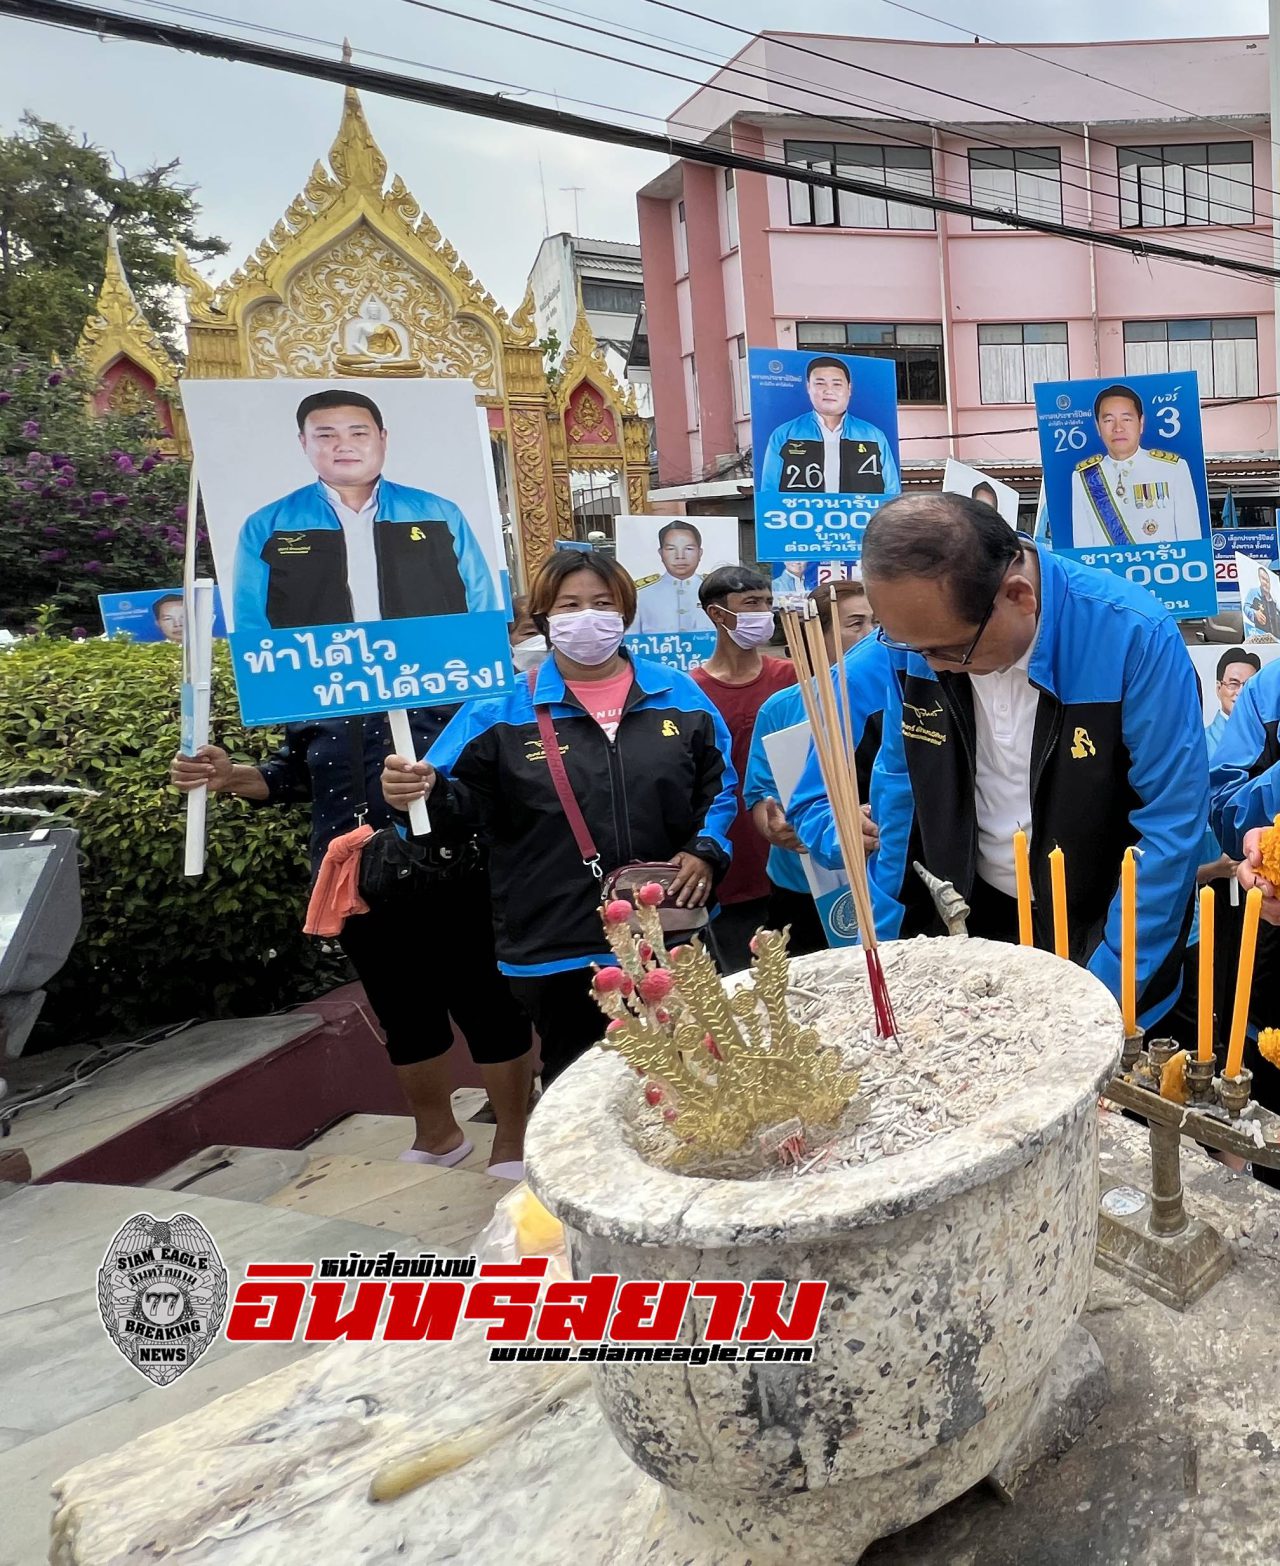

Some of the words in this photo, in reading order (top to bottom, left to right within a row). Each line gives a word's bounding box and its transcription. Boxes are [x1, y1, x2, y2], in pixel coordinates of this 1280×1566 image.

[1152, 386, 1182, 404] เบอร์
[1156, 407, 1181, 438] 3
[1054, 427, 1087, 452] 26
[786, 463, 823, 488] 26
[857, 454, 881, 475] 4
[782, 496, 879, 509] ชาวนารับ
[764, 511, 871, 533] 30,00
[815, 532, 850, 540] บาท
[1081, 543, 1186, 565] ชาวนารับ
[1216, 564, 1238, 578] 26
[243, 628, 397, 674] ทำได้ไว
[313, 659, 505, 706] ทำได้จริง!
